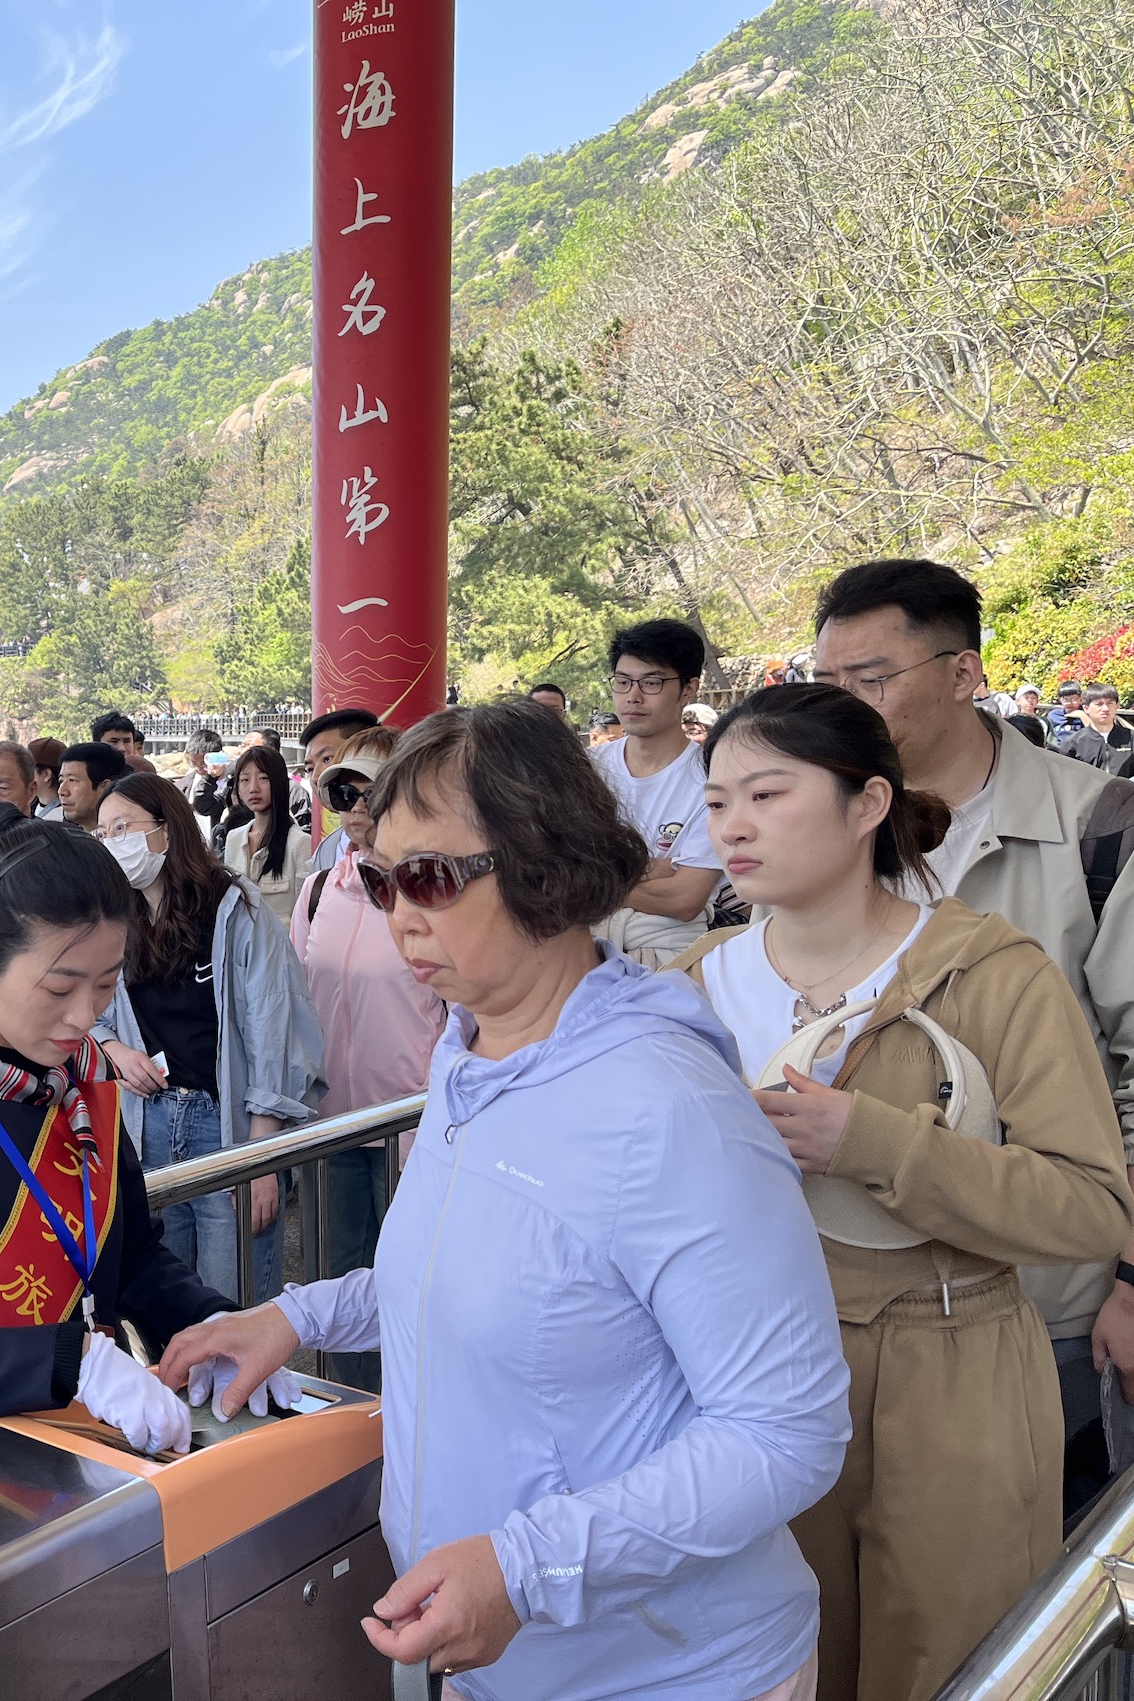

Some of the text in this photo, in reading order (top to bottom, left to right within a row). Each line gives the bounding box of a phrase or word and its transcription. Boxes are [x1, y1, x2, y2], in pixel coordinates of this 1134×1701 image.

[342, 0, 395, 26] 崂山
[341, 23, 396, 43] LaoShan
[336, 59, 397, 615] 海上名山第一
[508, 1165, 544, 1188] Quechua
